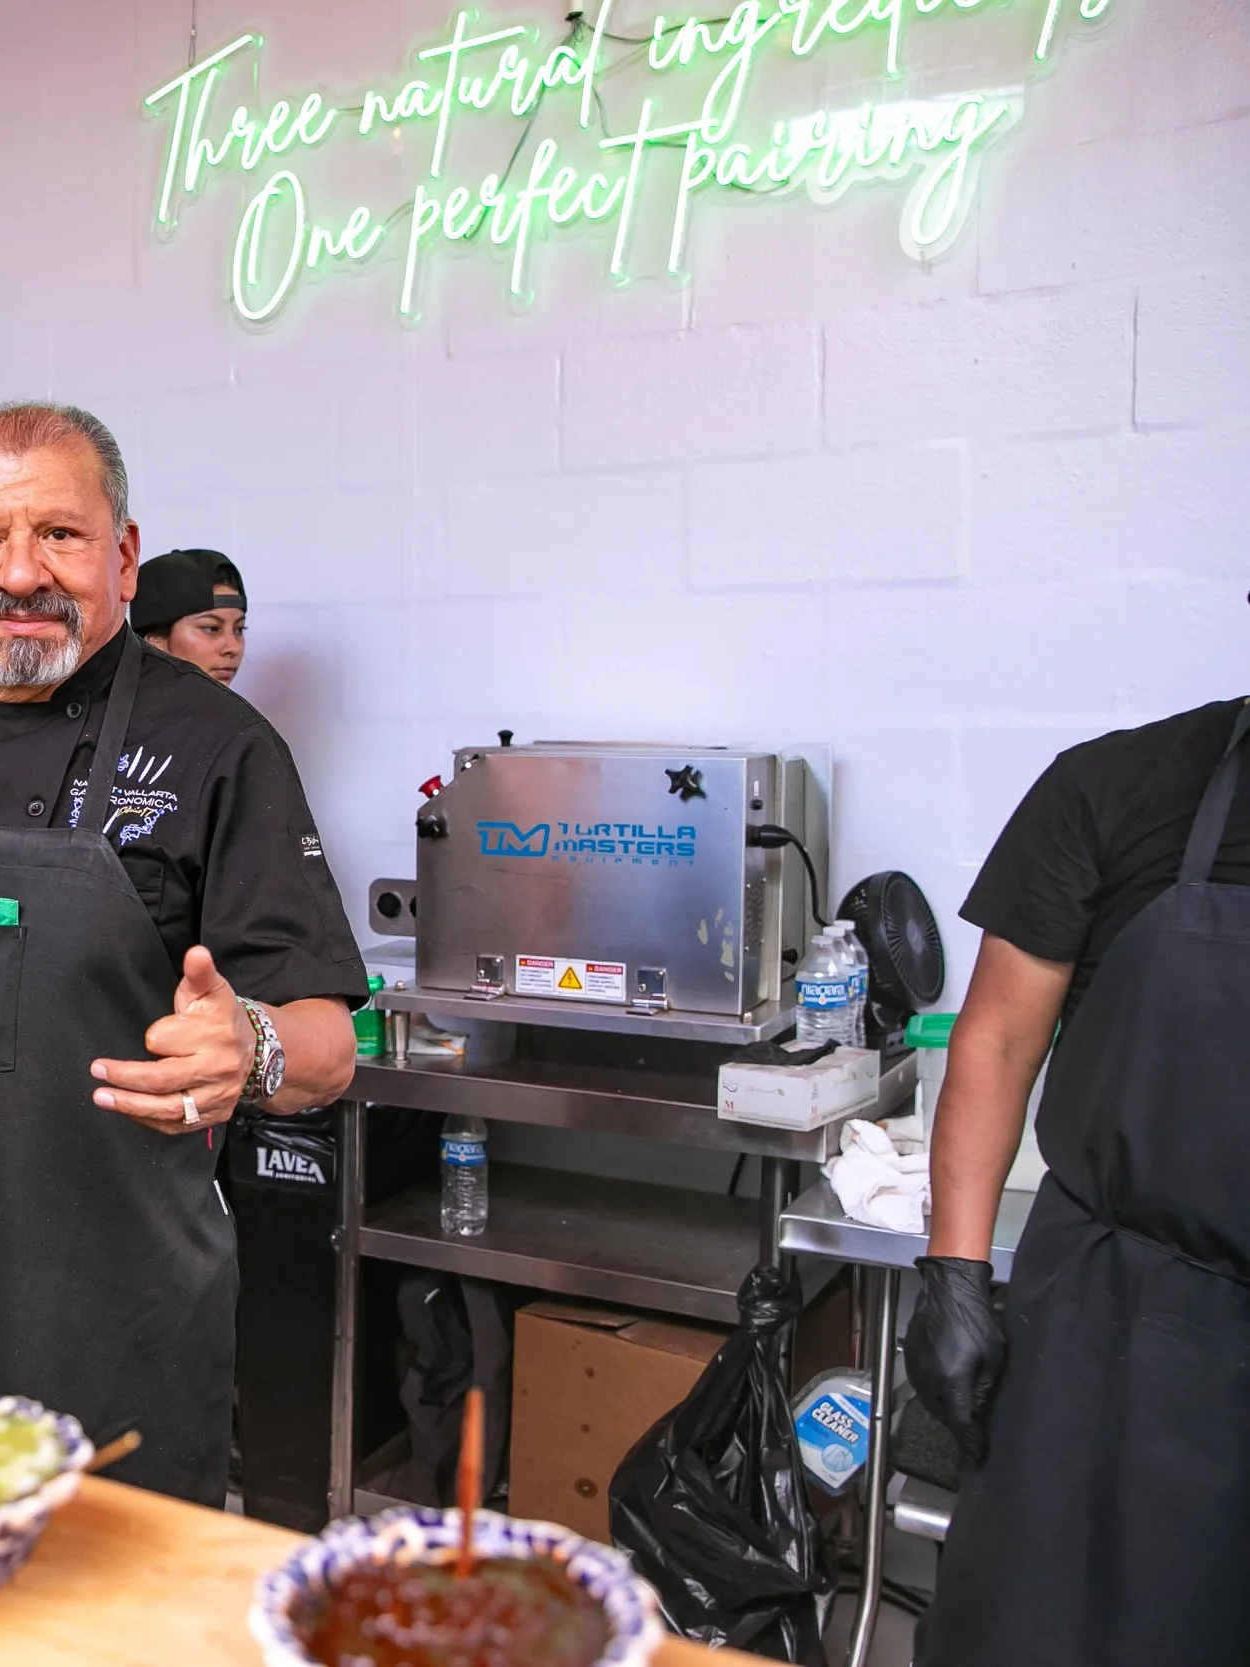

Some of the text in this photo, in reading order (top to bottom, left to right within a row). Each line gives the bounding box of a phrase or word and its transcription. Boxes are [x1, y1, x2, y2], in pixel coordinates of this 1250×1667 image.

[144, 33, 338, 225] Three
[357, 0, 614, 178] natural
[233, 94, 1008, 320] One perfect pairing
[123, 788, 178, 803] VALLARTA
[554, 838, 696, 857] MASTERS
[801, 983, 846, 998] niagara
[811, 1407, 859, 1444] CLEANER
[820, 1401, 854, 1428] GLASS
